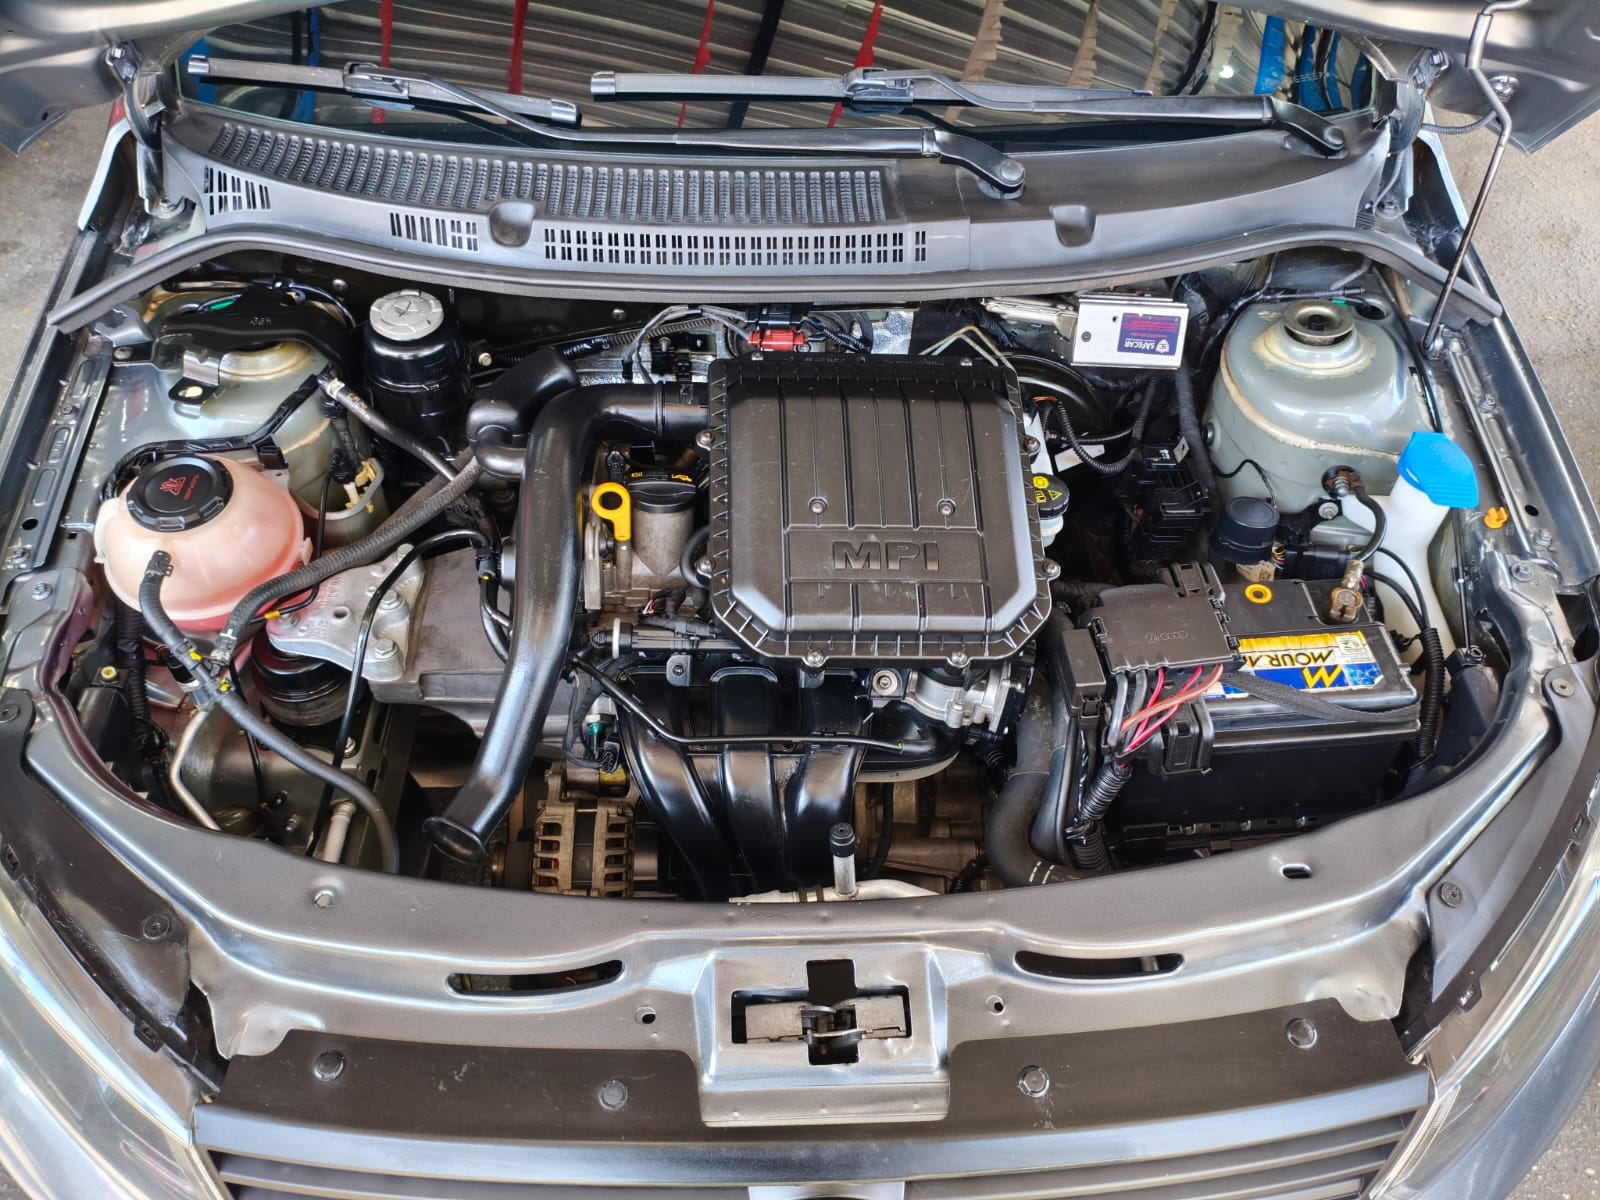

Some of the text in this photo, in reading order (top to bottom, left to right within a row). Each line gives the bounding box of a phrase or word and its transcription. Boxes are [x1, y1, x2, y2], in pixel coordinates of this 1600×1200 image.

[1124, 340, 1155, 349] SAFECAR
[832, 541, 940, 571] MPI
[1248, 650, 1333, 667] MOURA
